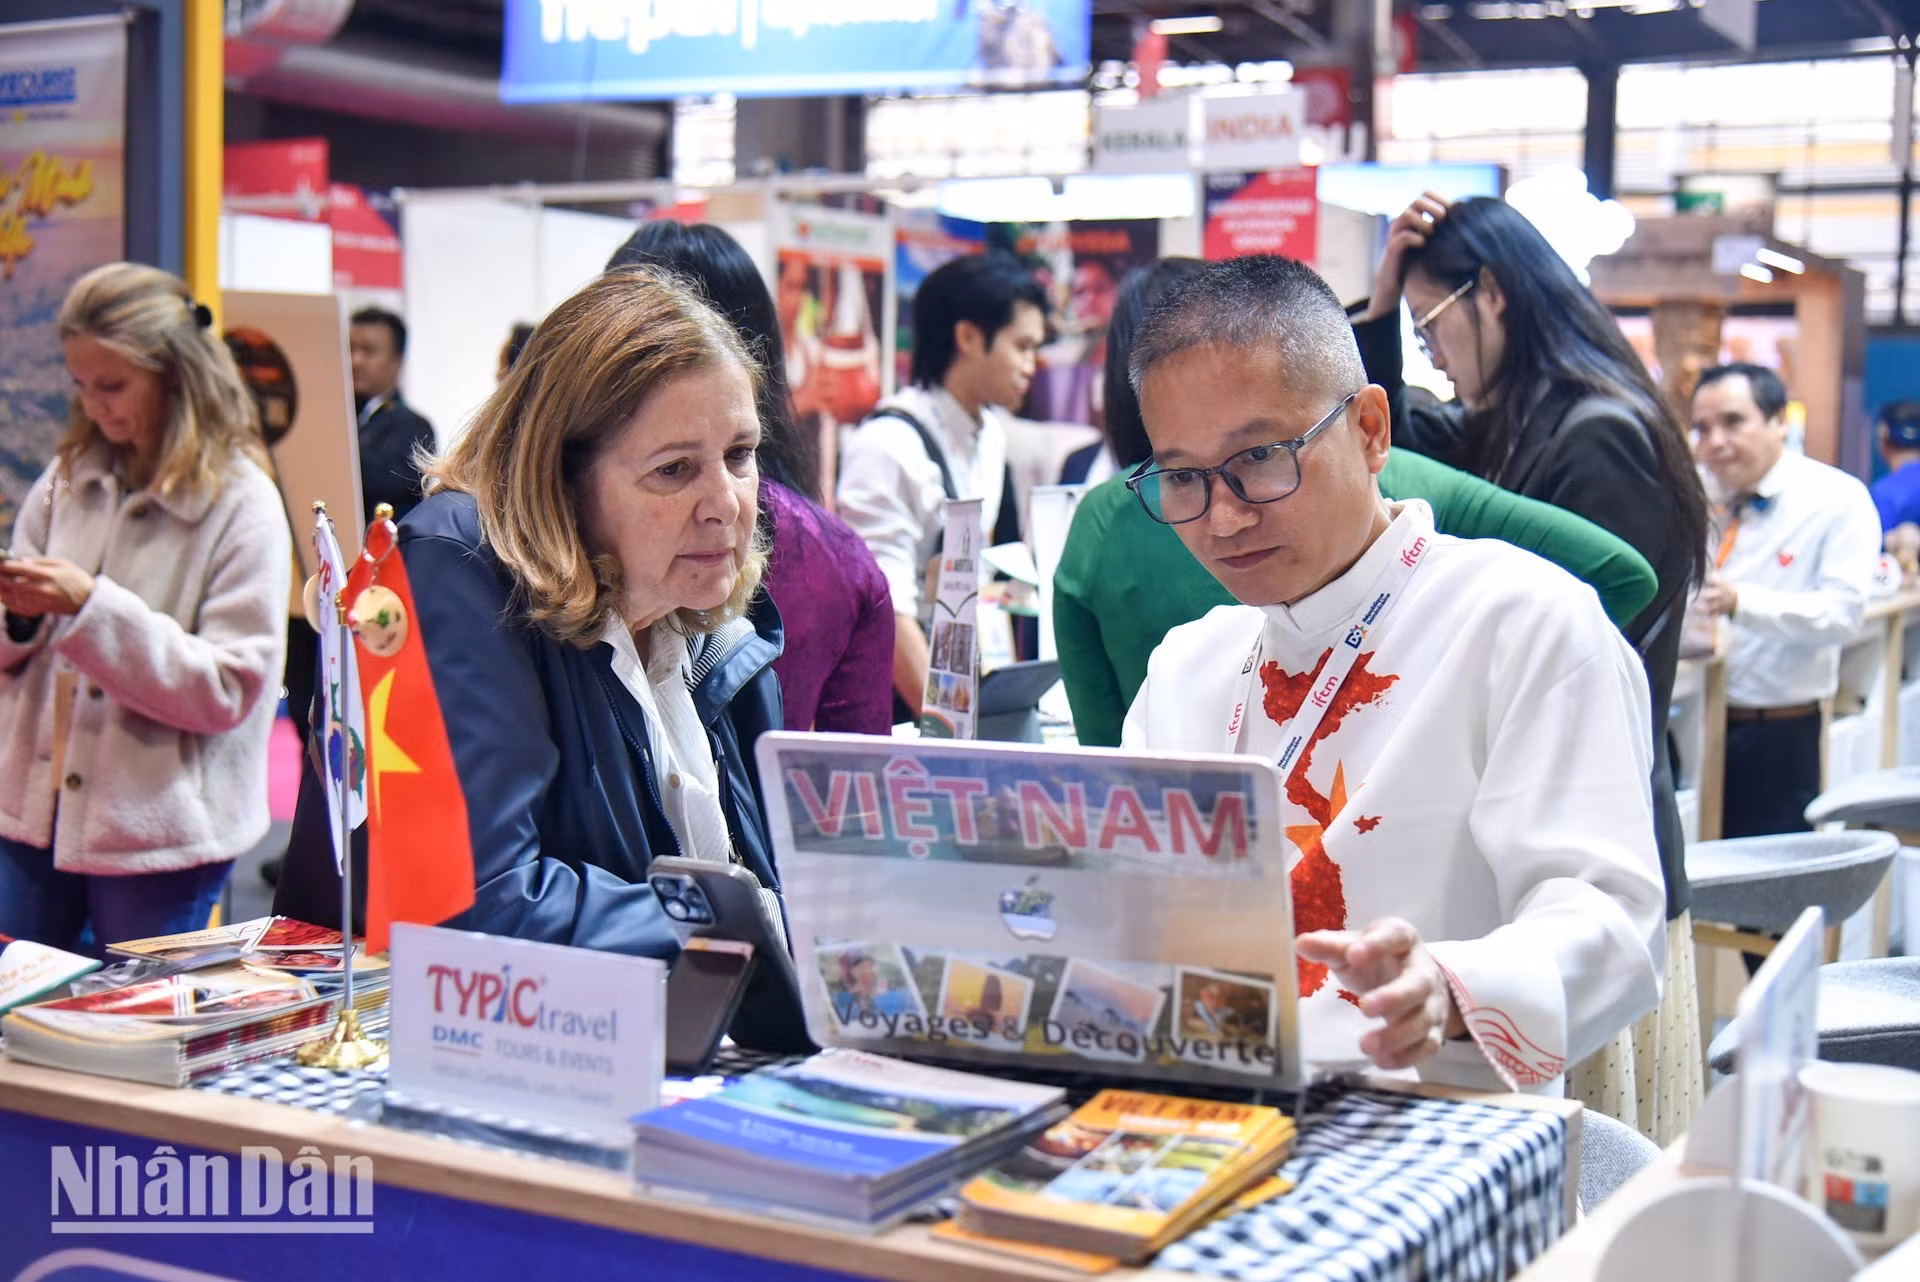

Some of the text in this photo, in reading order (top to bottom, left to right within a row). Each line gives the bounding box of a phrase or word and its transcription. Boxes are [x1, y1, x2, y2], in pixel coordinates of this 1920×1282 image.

[1102, 129, 1186, 151] KERALA
[1207, 114, 1294, 142] INDIA
[1401, 537, 1426, 567] iftm
[1312, 676, 1338, 707] iftm
[1229, 703, 1242, 736] iftm
[786, 755, 1249, 861] VIỆT NAM
[834, 1002, 992, 1041] Voyages
[1003, 1015, 1027, 1041] &
[432, 1025, 484, 1048] DMC
[495, 1038, 542, 1064] TOURS
[559, 1049, 615, 1076] EVENTS
